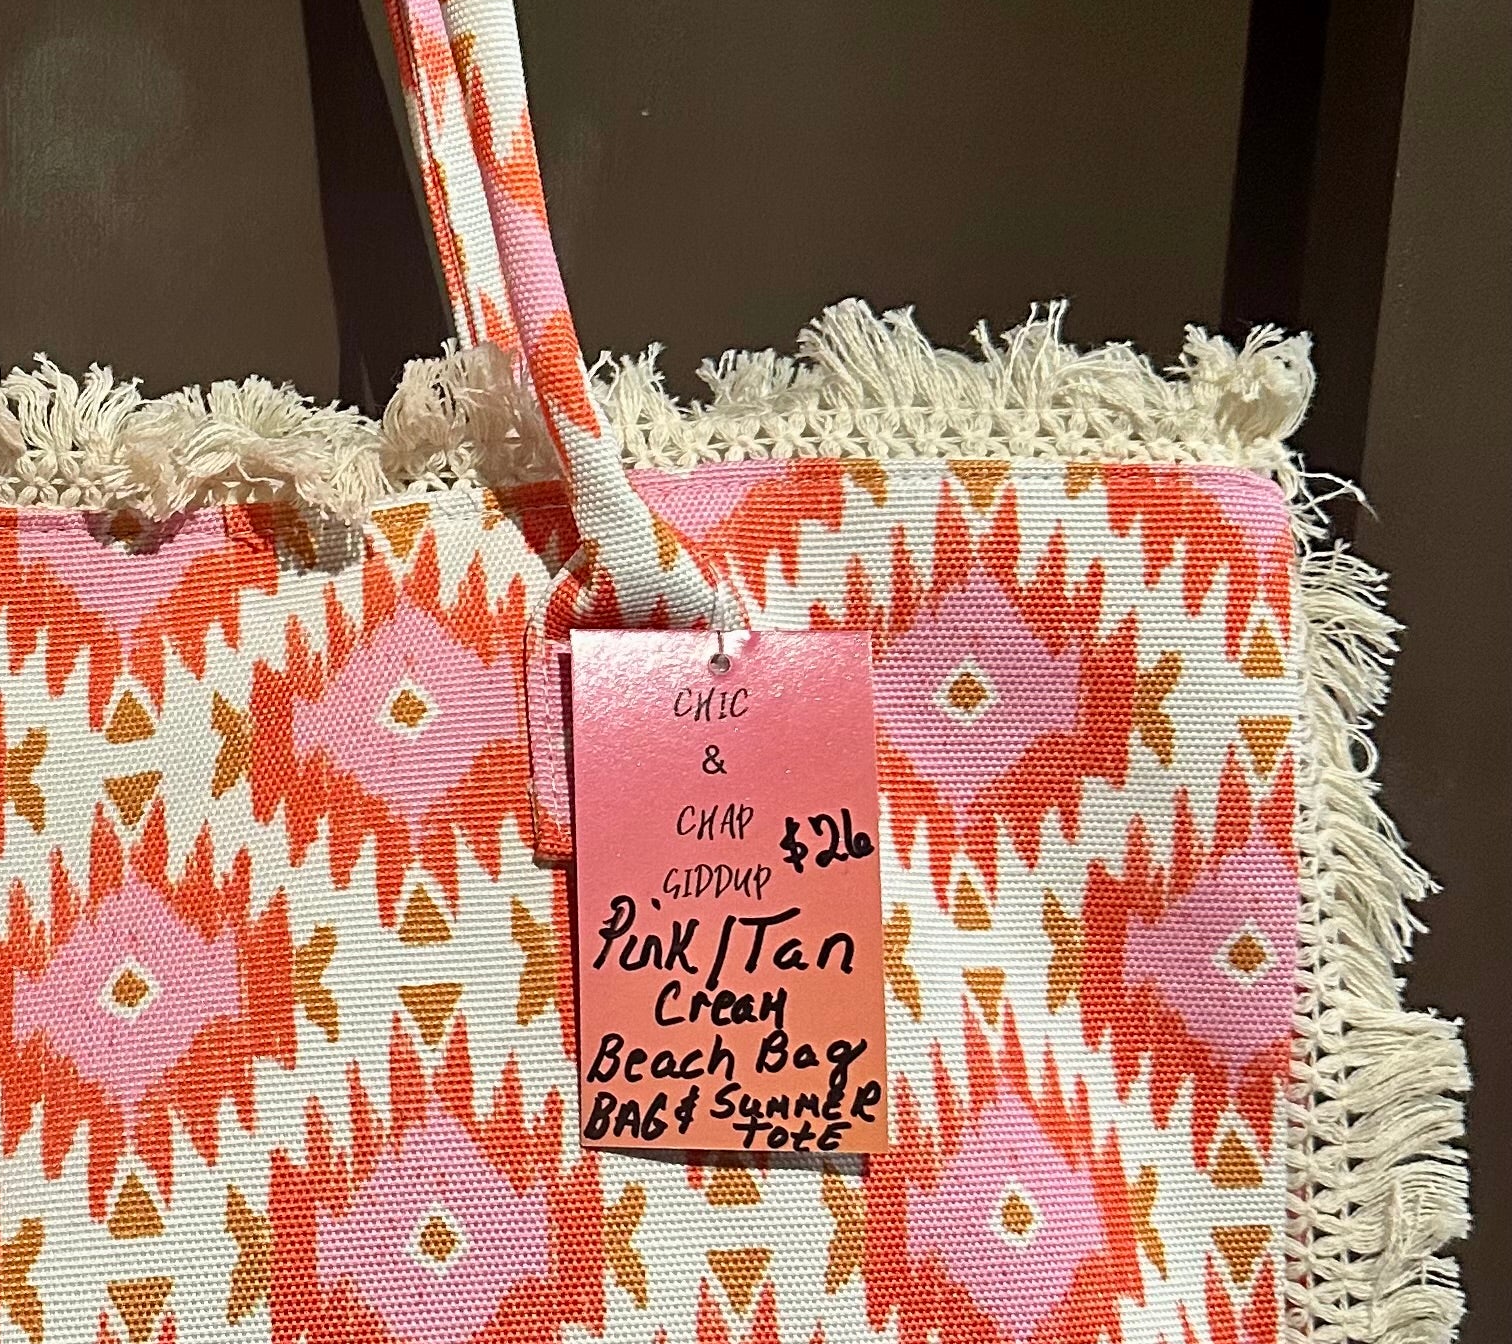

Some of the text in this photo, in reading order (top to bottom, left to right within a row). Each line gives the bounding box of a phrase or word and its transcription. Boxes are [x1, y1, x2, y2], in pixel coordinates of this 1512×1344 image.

[673, 686, 750, 722] CHIC
[701, 744, 728, 775] &
[676, 802, 754, 841] CHAP
[779, 807, 875, 874] $26
[662, 863, 772, 901] GIDDUP
[586, 1029, 868, 1090] Beach Bag
